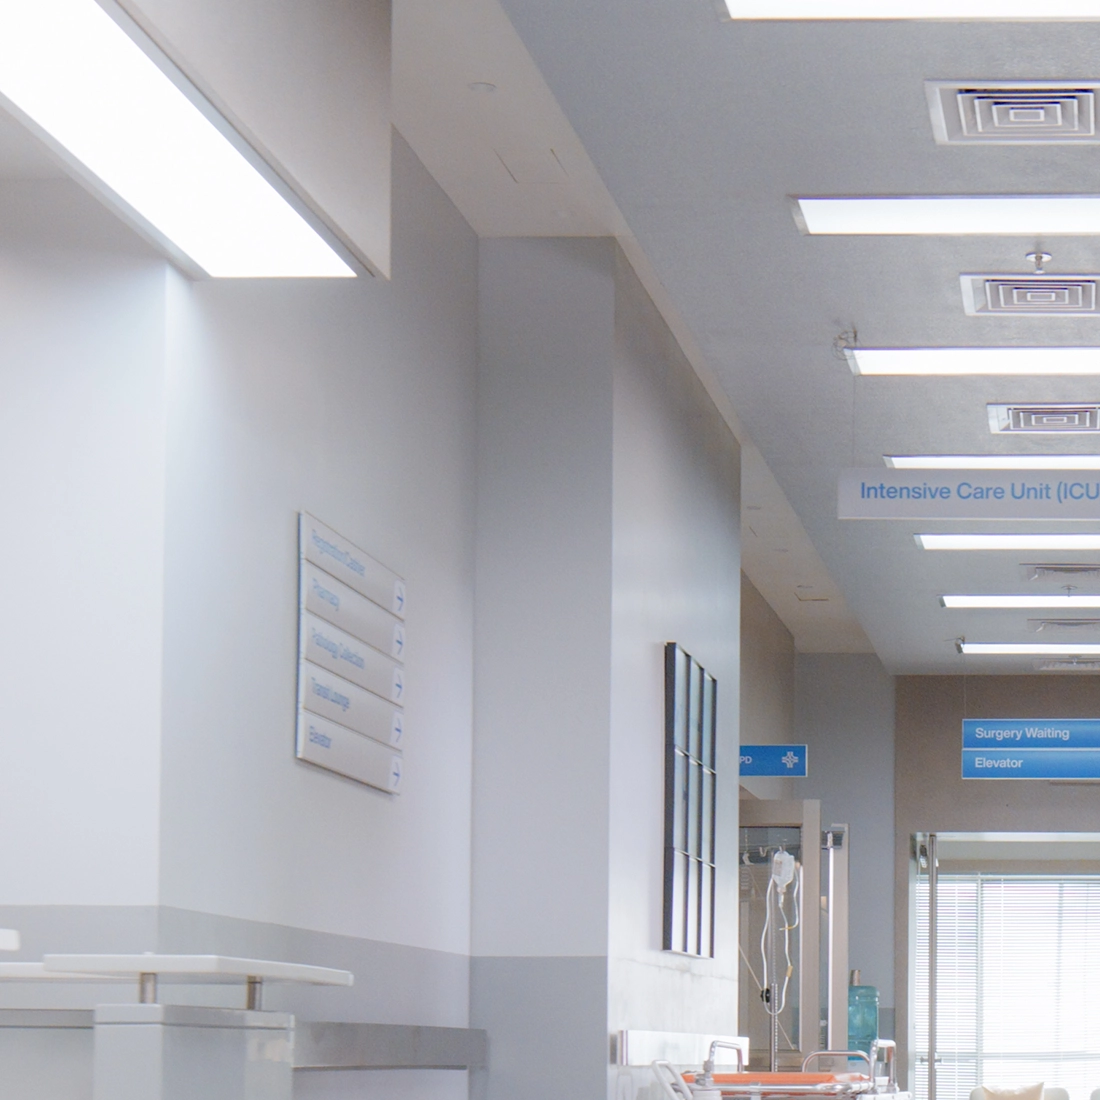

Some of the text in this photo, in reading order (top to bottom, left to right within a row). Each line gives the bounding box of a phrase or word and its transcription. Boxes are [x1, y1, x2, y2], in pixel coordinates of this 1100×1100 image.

[860, 481, 951, 500] Intensive
[956, 481, 1006, 500] Care
[1010, 482, 1052, 500] Unit
[975, 727, 1070, 741] Surgery Waiting
[739, 755, 753, 765] PD
[975, 757, 1024, 768] Elevator
